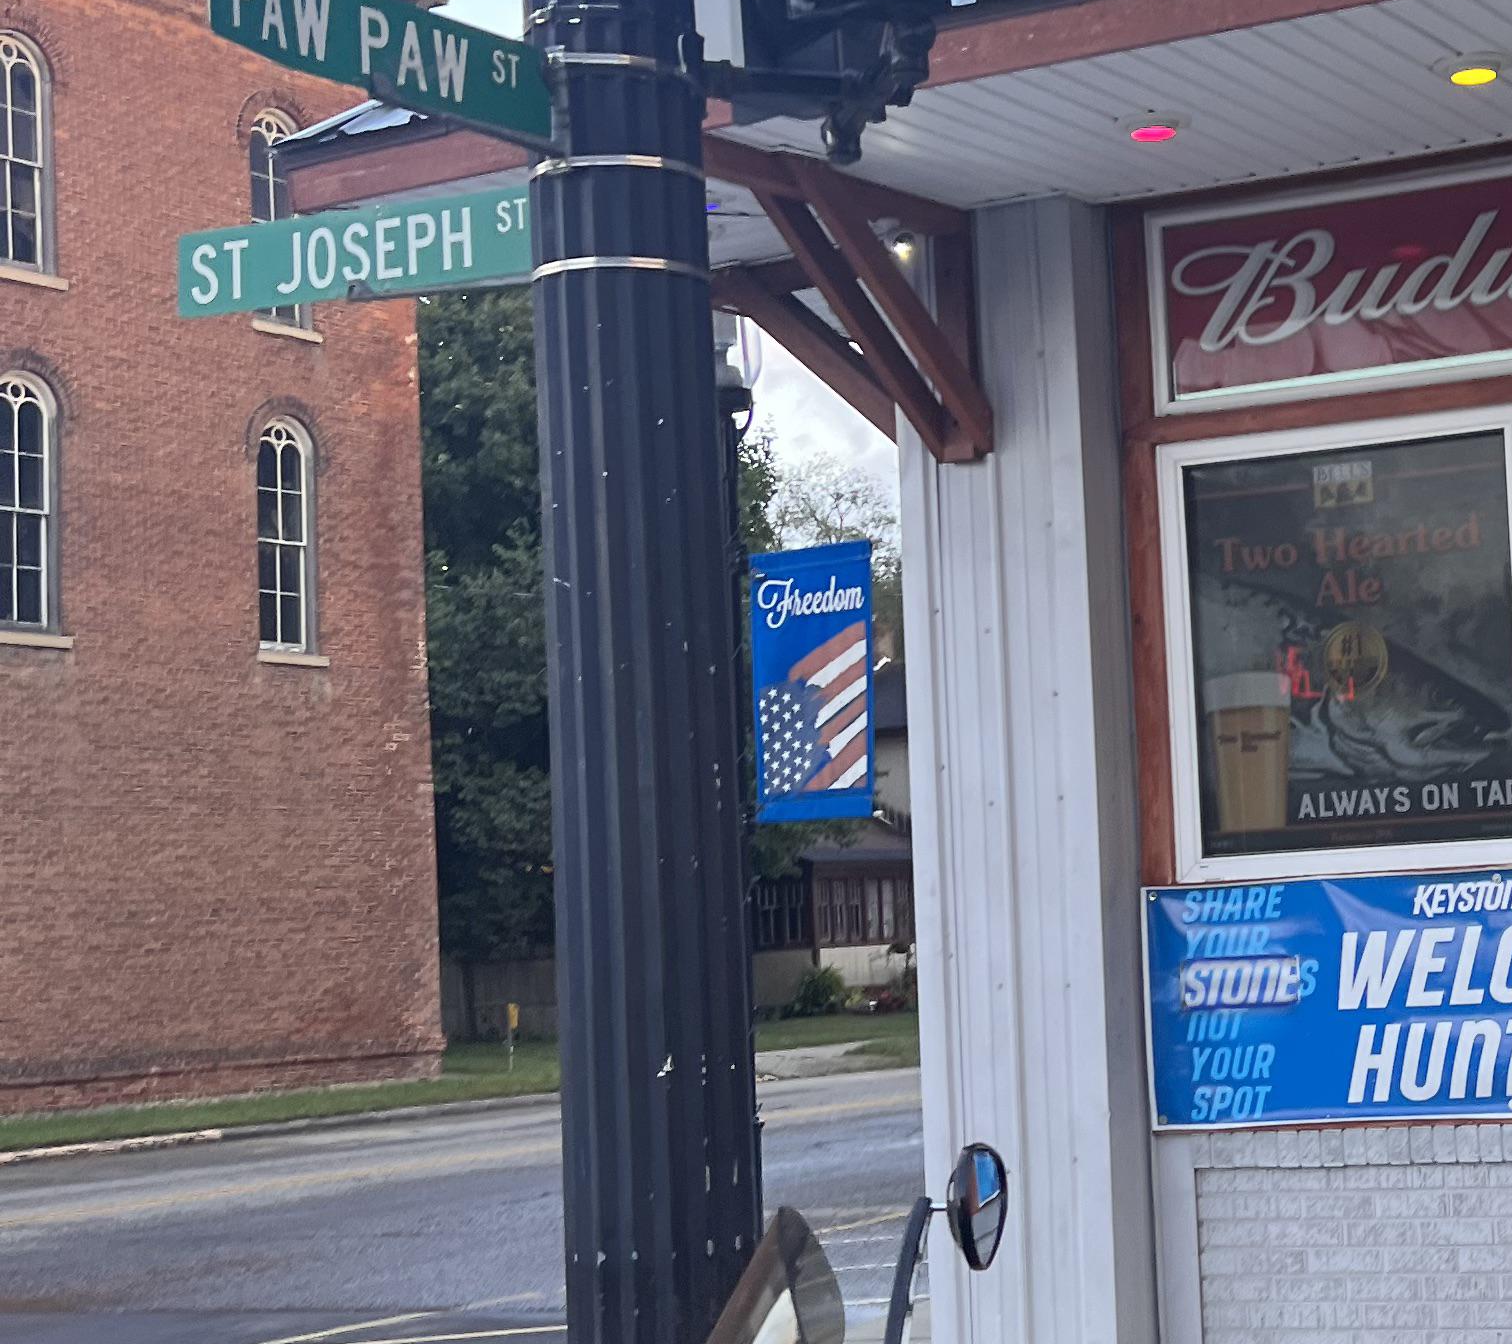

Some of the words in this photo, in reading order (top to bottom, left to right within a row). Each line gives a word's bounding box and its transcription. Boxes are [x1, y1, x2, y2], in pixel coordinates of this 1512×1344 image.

[360, 5, 468, 103] PAW
[492, 50, 520, 89] ST
[191, 239, 249, 305] ST
[277, 206, 473, 296] JOSEPH
[496, 198, 527, 233] ST
[1215, 536, 1297, 573] Two
[1311, 513, 1482, 565] Hearted
[757, 576, 865, 629] Freedom
[1316, 569, 1383, 607] Ale
[1298, 786, 1412, 819] ALWAYS
[1421, 782, 1460, 811] ON
[1182, 885, 1285, 923] SHARE
[1185, 925, 1270, 960] YOUR
[1183, 958, 1320, 1006] STONES
[1186, 1008, 1247, 1042] NOT
[1191, 1043, 1276, 1082] YOUR
[1191, 1085, 1272, 1122] SPOT
